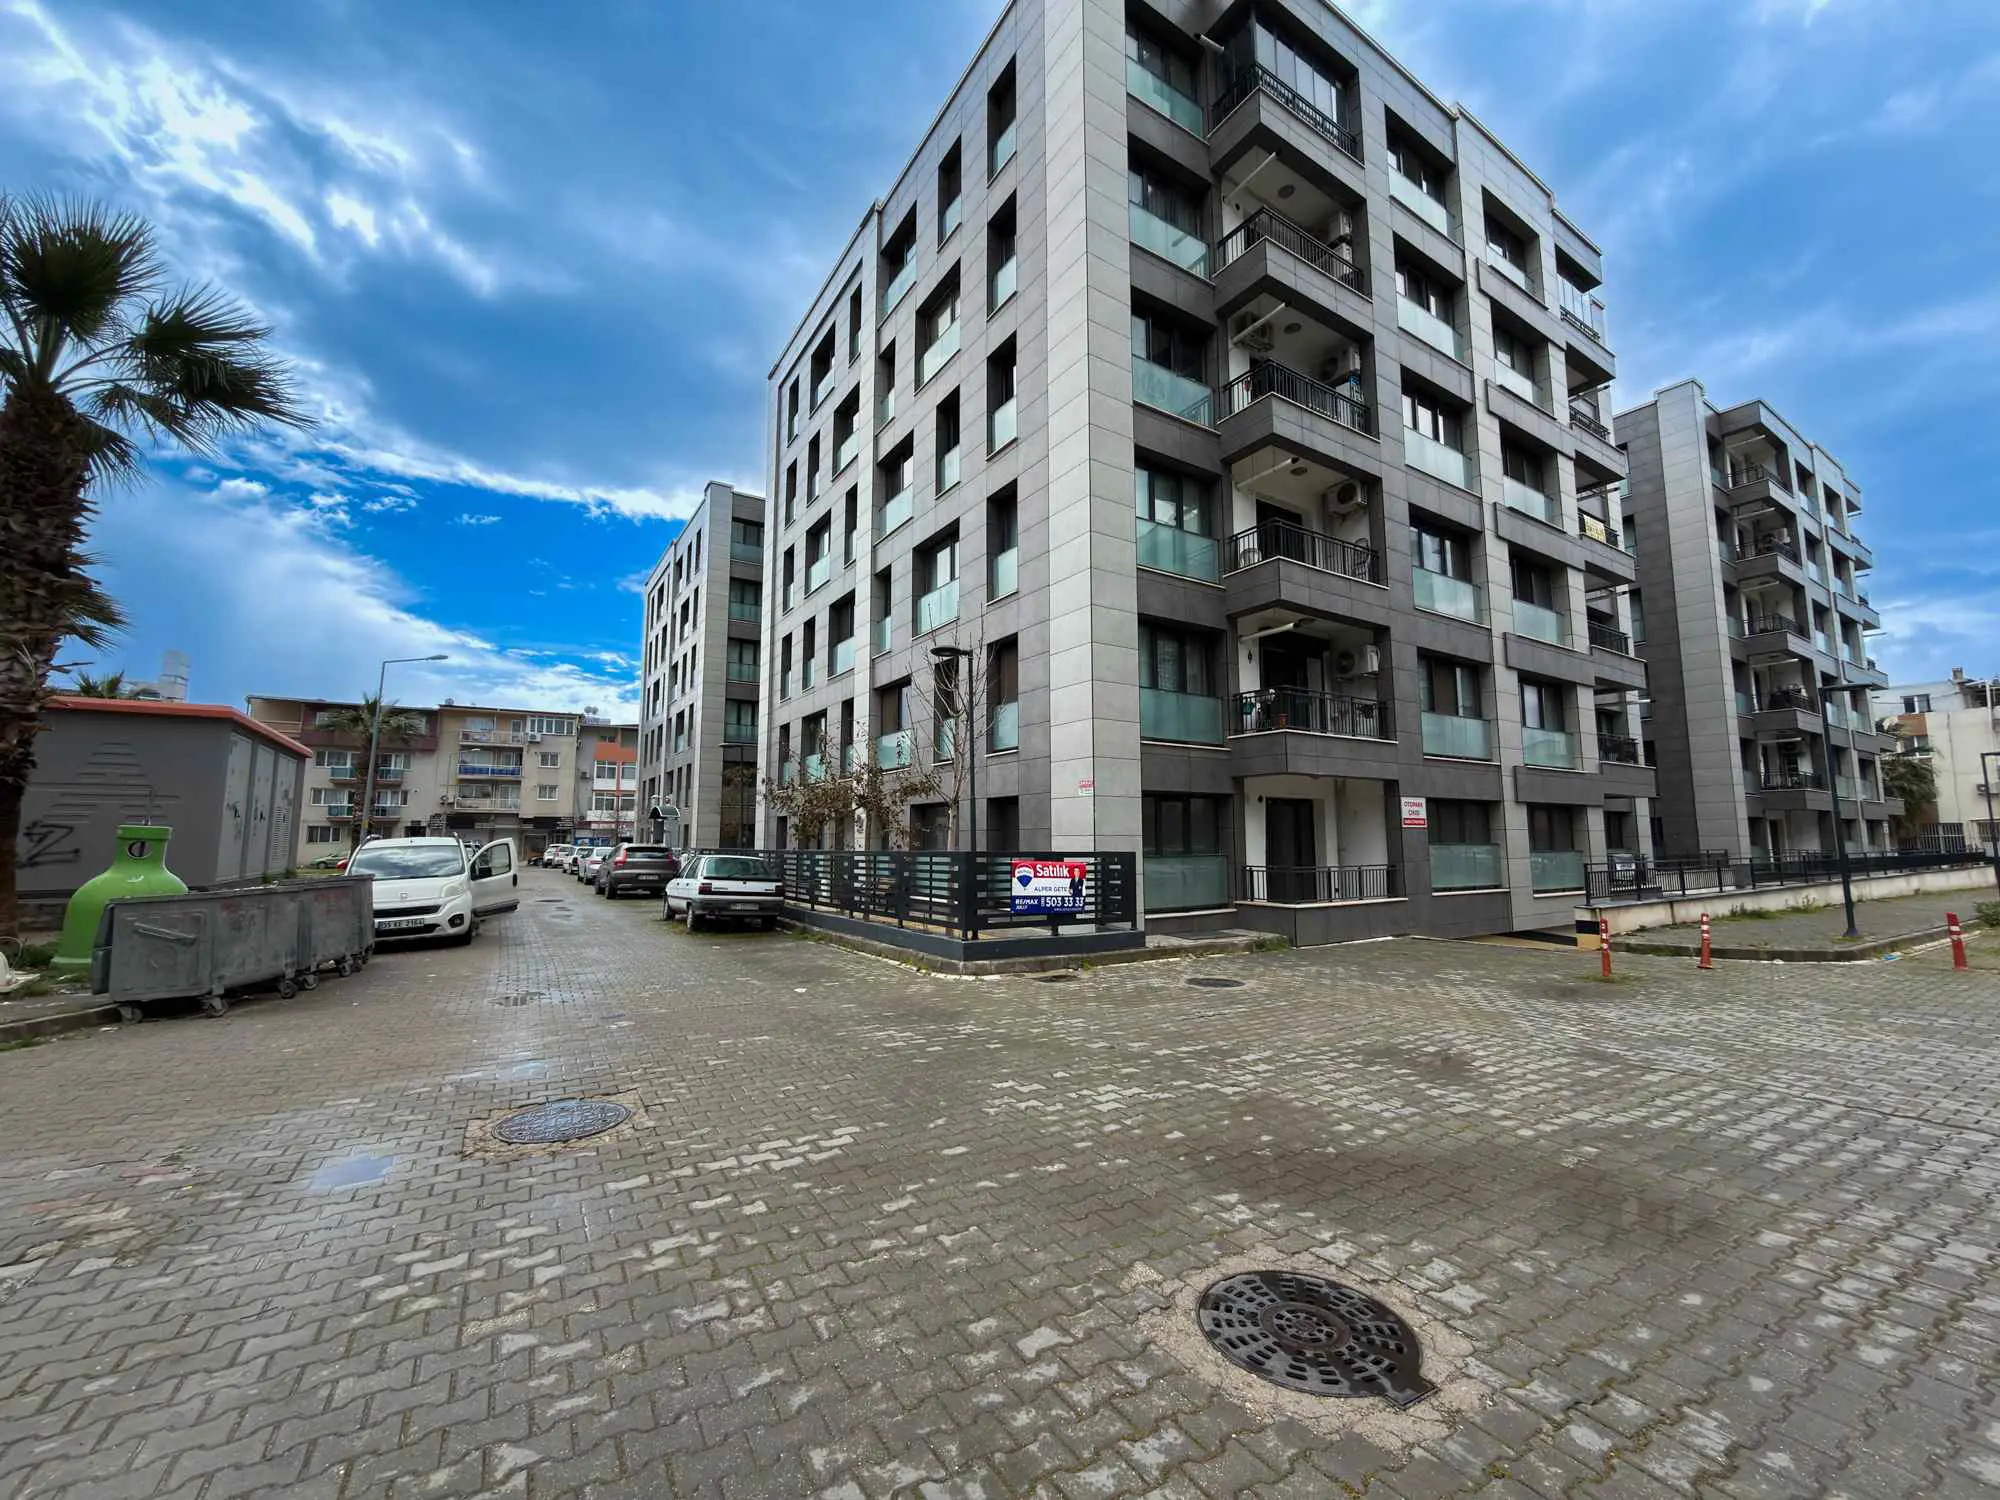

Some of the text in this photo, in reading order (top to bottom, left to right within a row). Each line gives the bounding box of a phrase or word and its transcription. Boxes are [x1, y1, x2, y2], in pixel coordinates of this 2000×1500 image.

[1036, 864, 1070, 877] Satılık
[1046, 897, 1062, 907] 503
[1063, 897, 1074, 907] 33
[1075, 897, 1084, 907] 33
